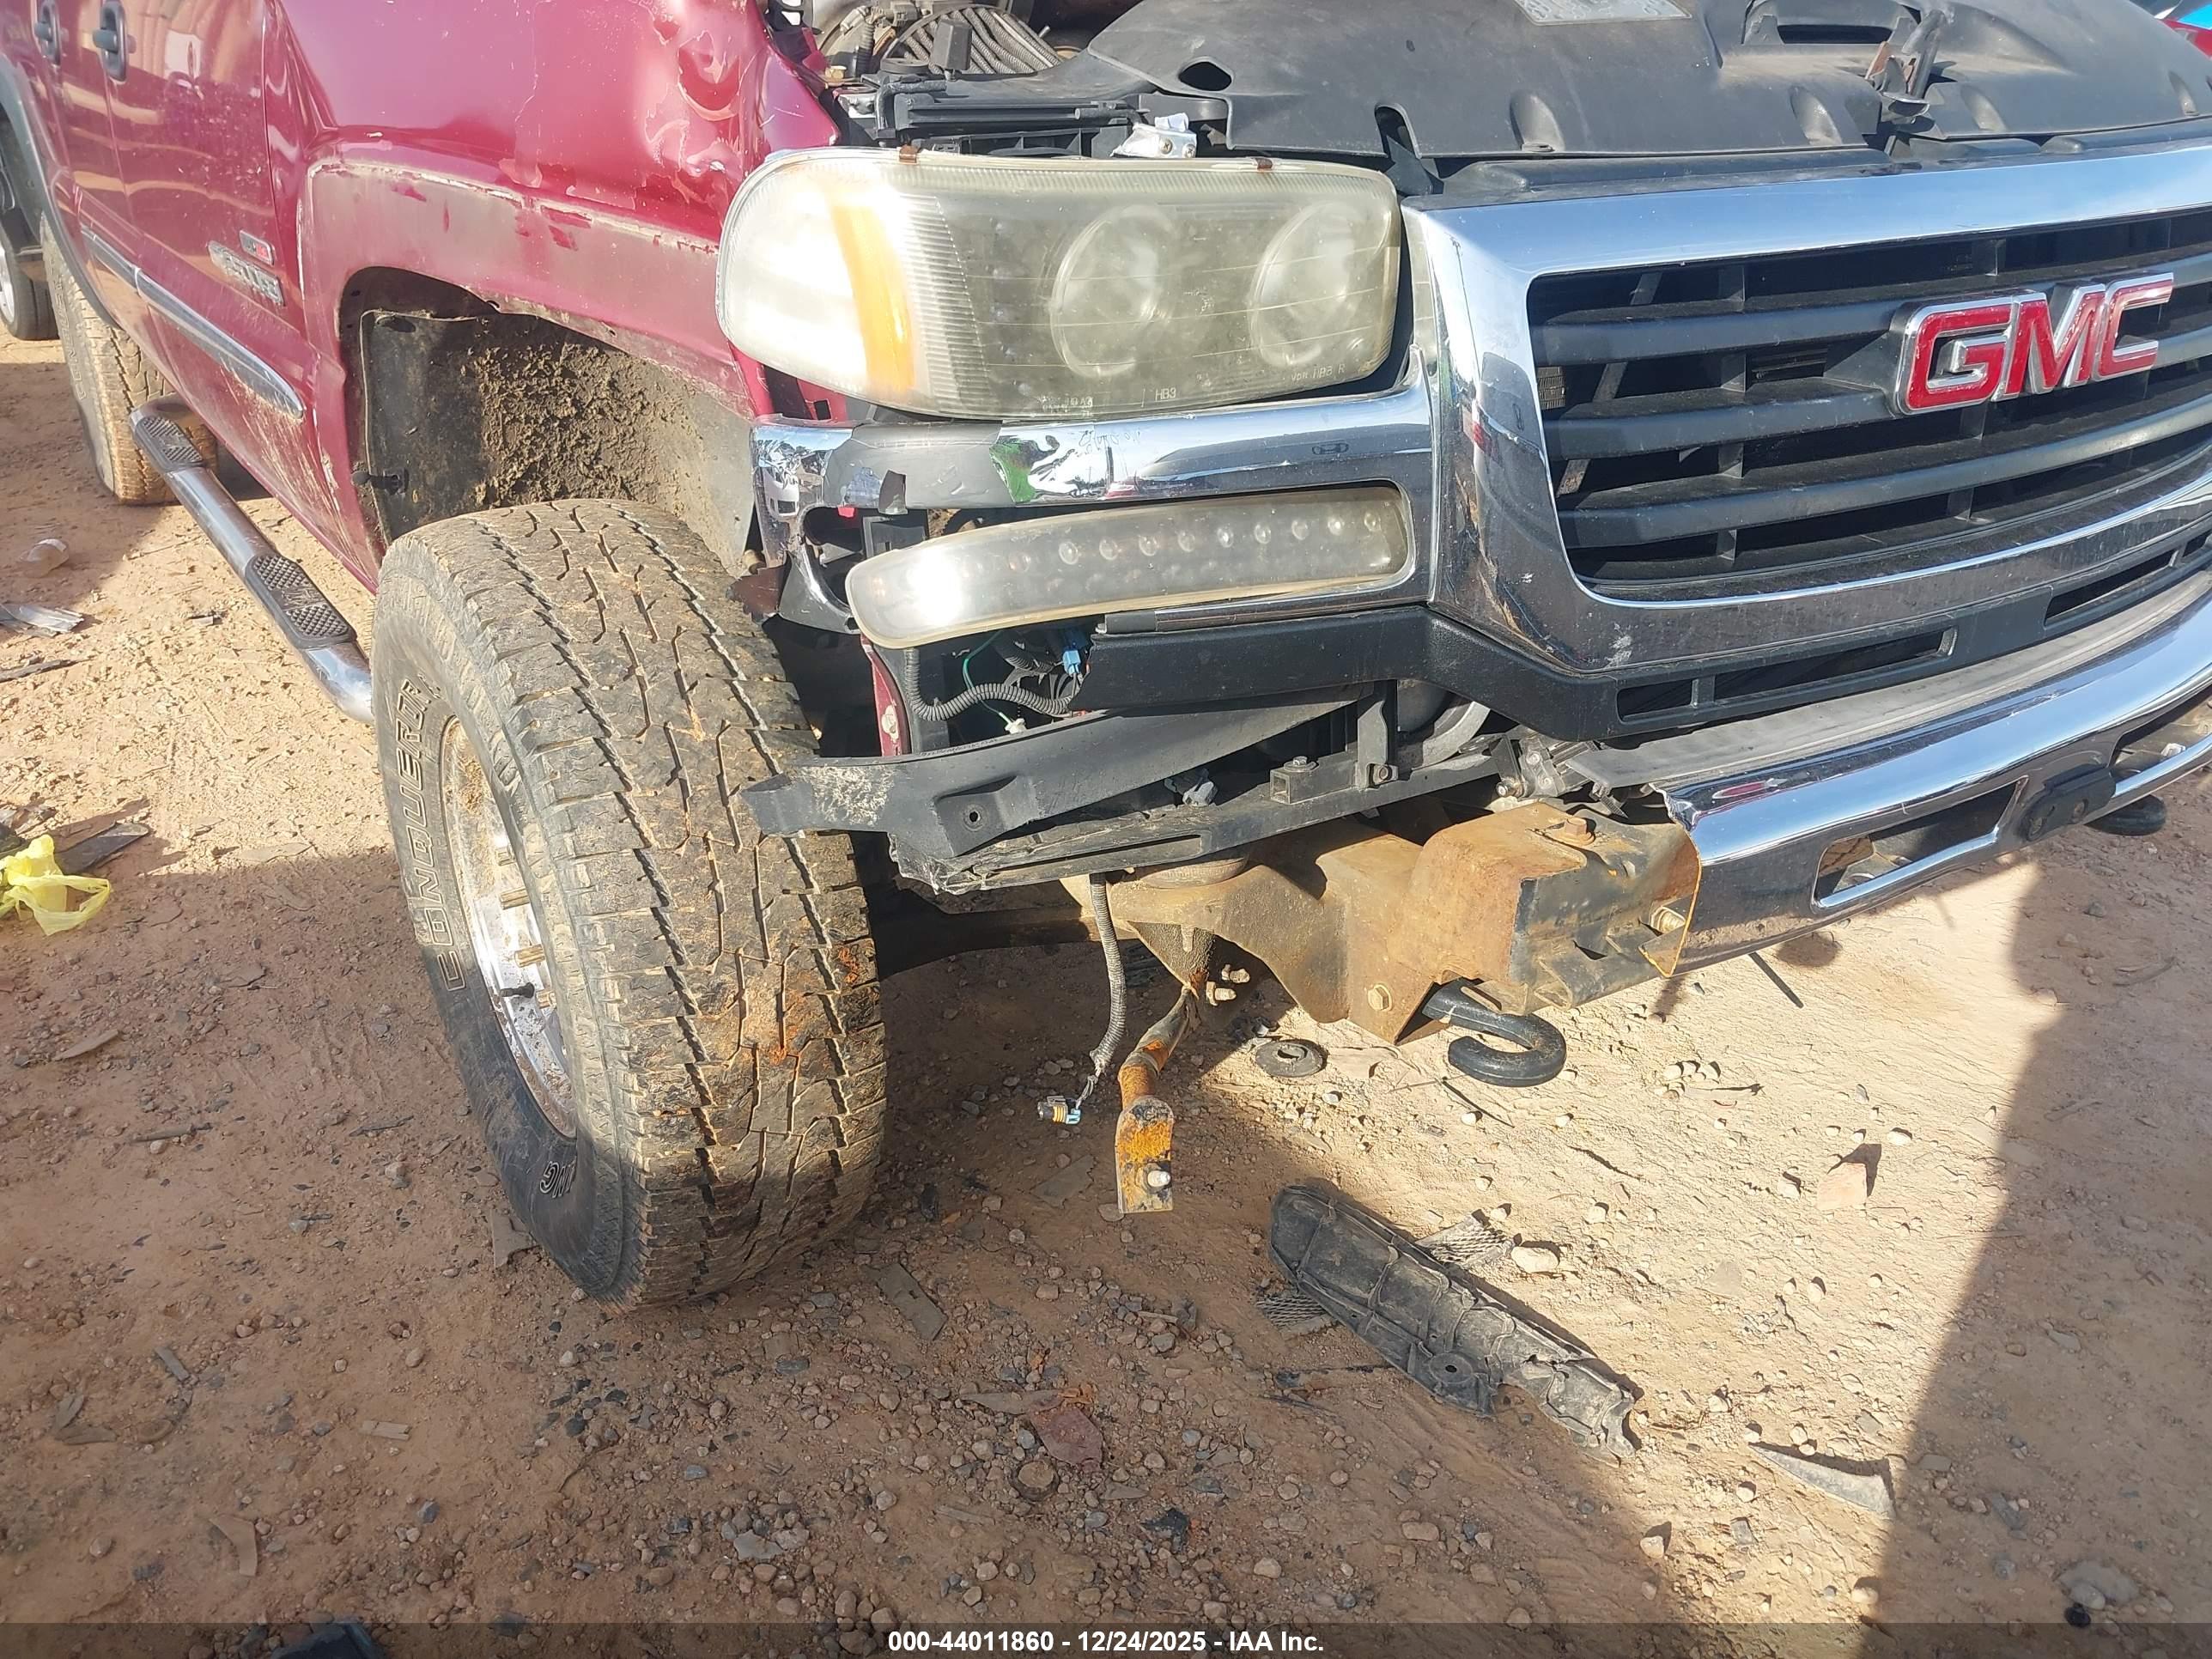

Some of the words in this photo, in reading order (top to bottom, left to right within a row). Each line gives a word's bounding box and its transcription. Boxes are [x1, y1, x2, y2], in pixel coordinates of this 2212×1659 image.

[1154, 386, 1176, 402] HB3
[1894, 271, 2174, 416] GMC
[396, 678, 467, 992] CONQUEROR
